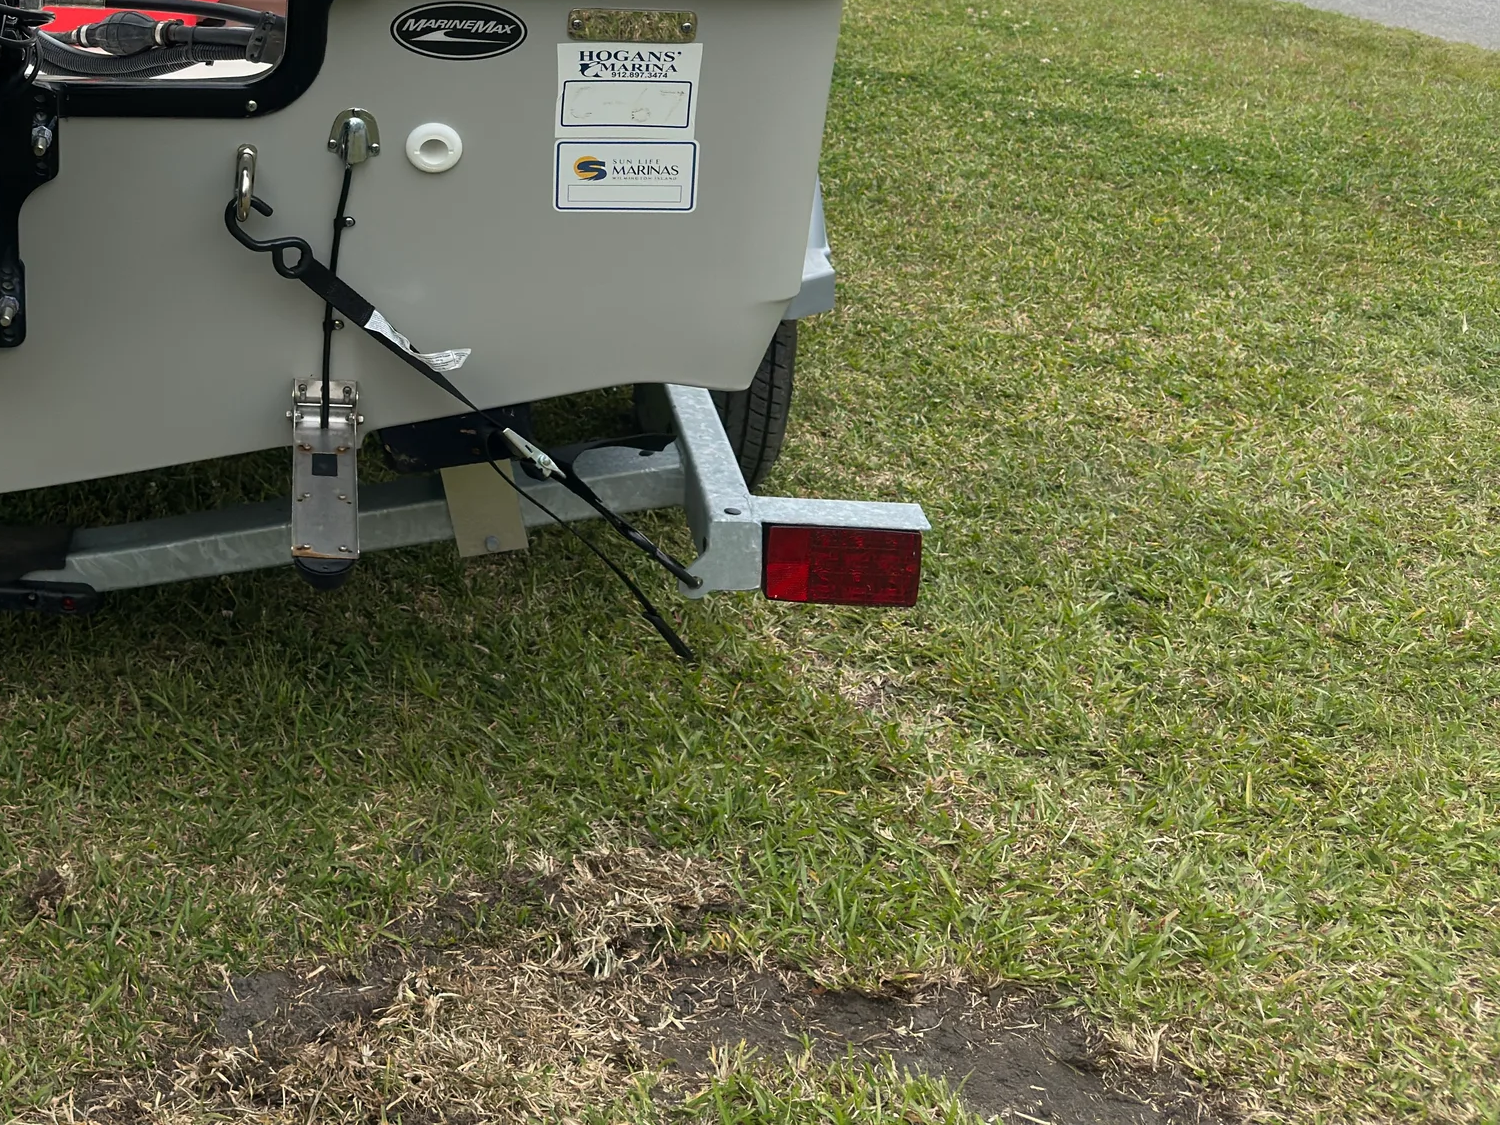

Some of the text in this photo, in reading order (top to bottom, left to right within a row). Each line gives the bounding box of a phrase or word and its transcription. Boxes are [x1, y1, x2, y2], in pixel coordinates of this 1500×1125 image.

[600, 62, 678, 73] MARINA
[611, 71, 668, 79] 912.897.3474
[612, 164, 679, 176] MARINAS
